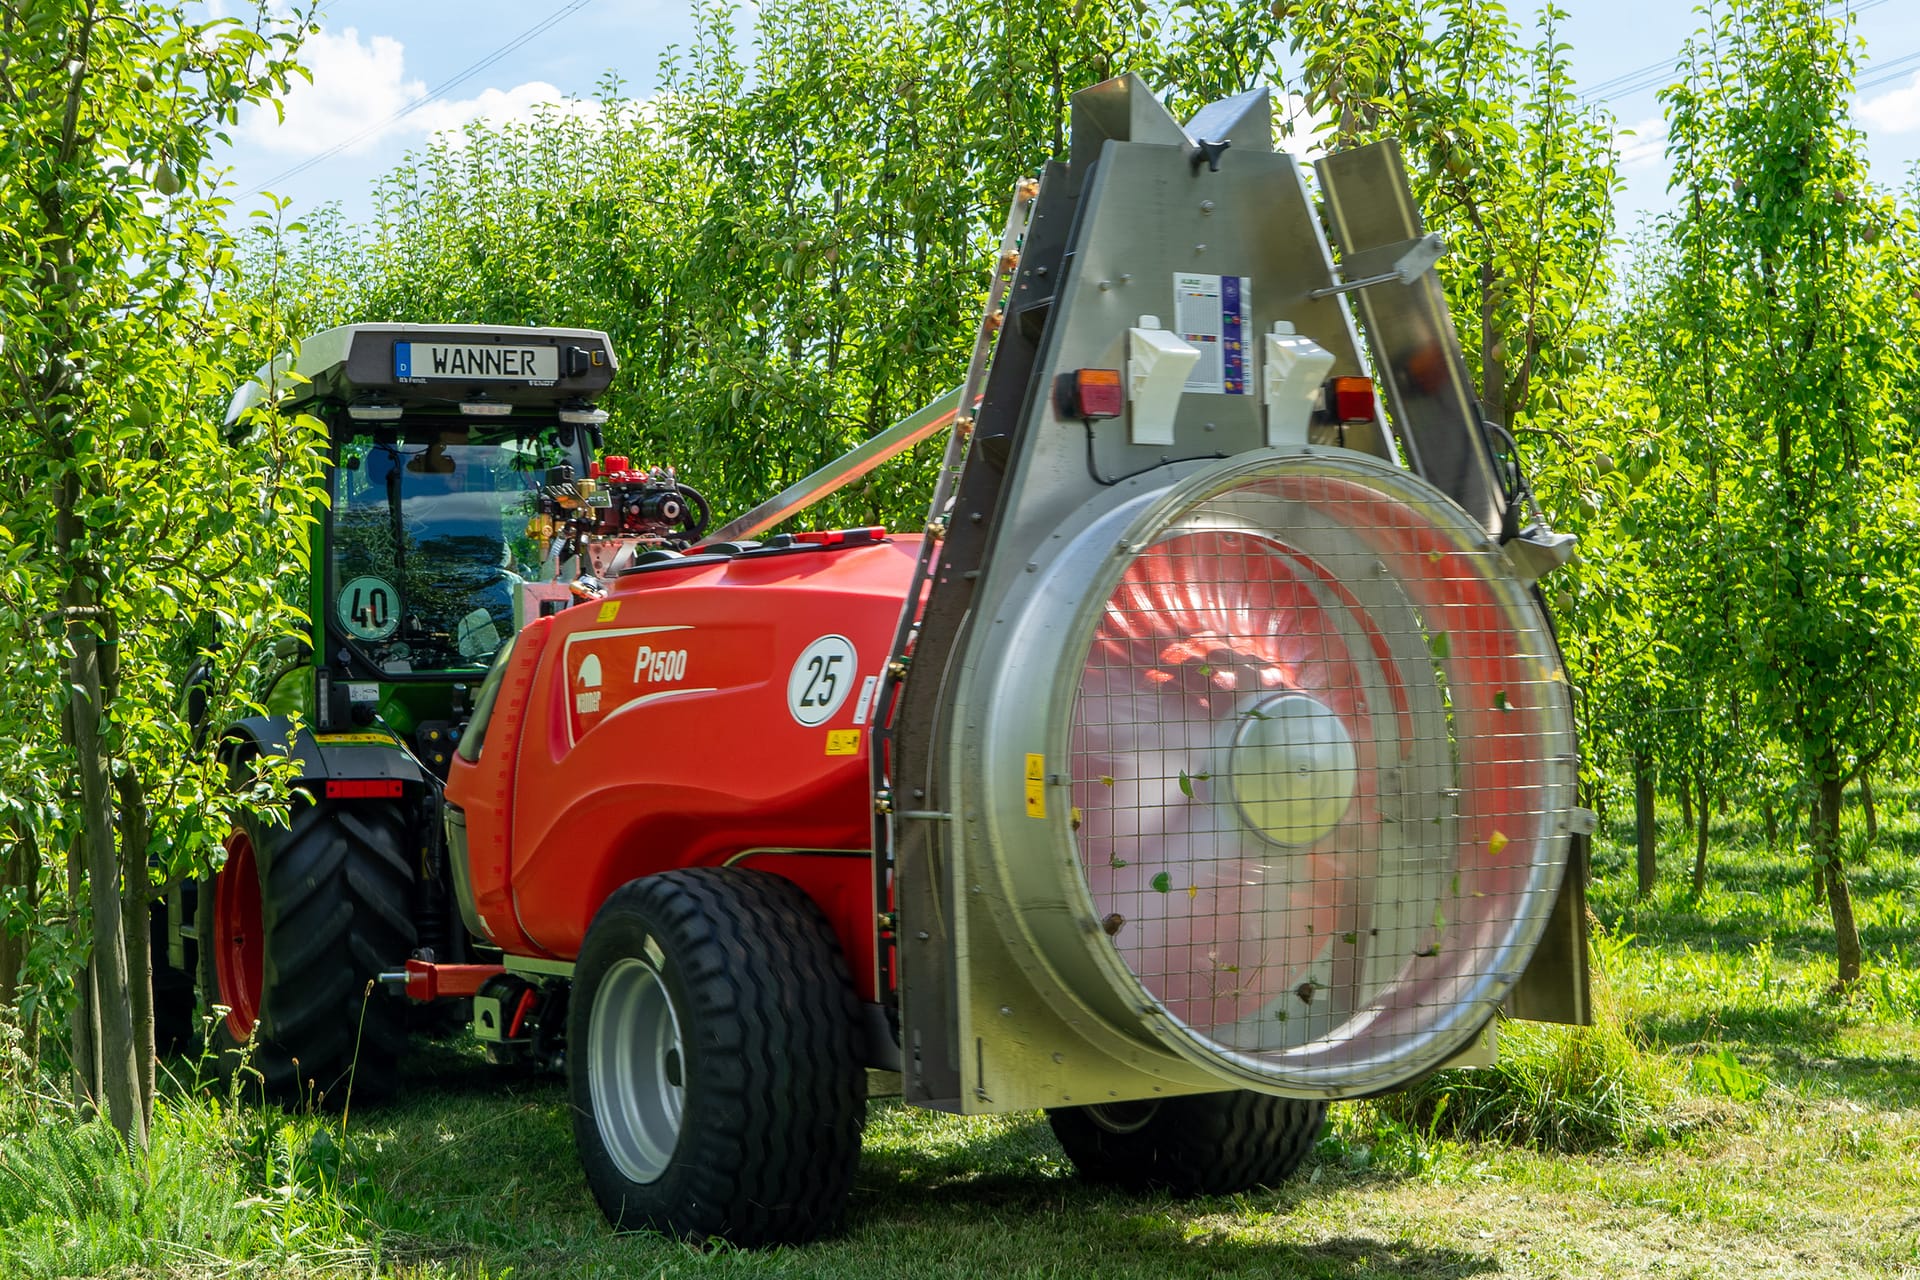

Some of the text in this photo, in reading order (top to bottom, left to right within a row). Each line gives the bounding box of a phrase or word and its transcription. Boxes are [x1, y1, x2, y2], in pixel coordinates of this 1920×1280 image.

[400, 363, 407, 371] D
[432, 347, 536, 376] WANNER
[351, 588, 388, 629] 40
[633, 645, 688, 683] P1500
[799, 655, 844, 707] 25
